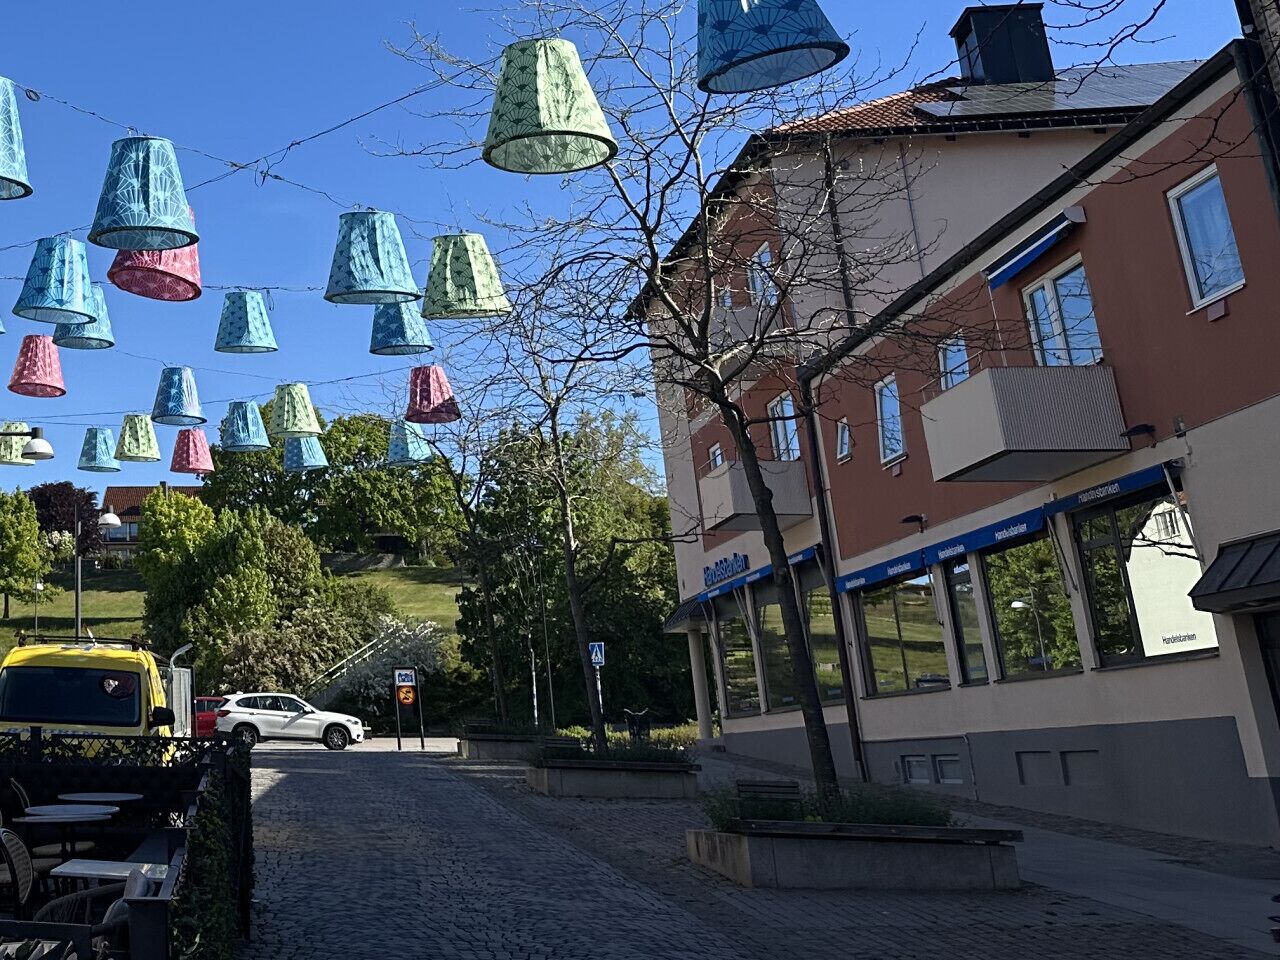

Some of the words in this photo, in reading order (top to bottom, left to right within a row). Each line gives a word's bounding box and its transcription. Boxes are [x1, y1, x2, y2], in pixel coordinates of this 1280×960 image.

[1078, 482, 1120, 504] Handelsbanken
[994, 522, 1028, 541] Handelsbanken
[1161, 633, 1197, 645] Handelsbanken
